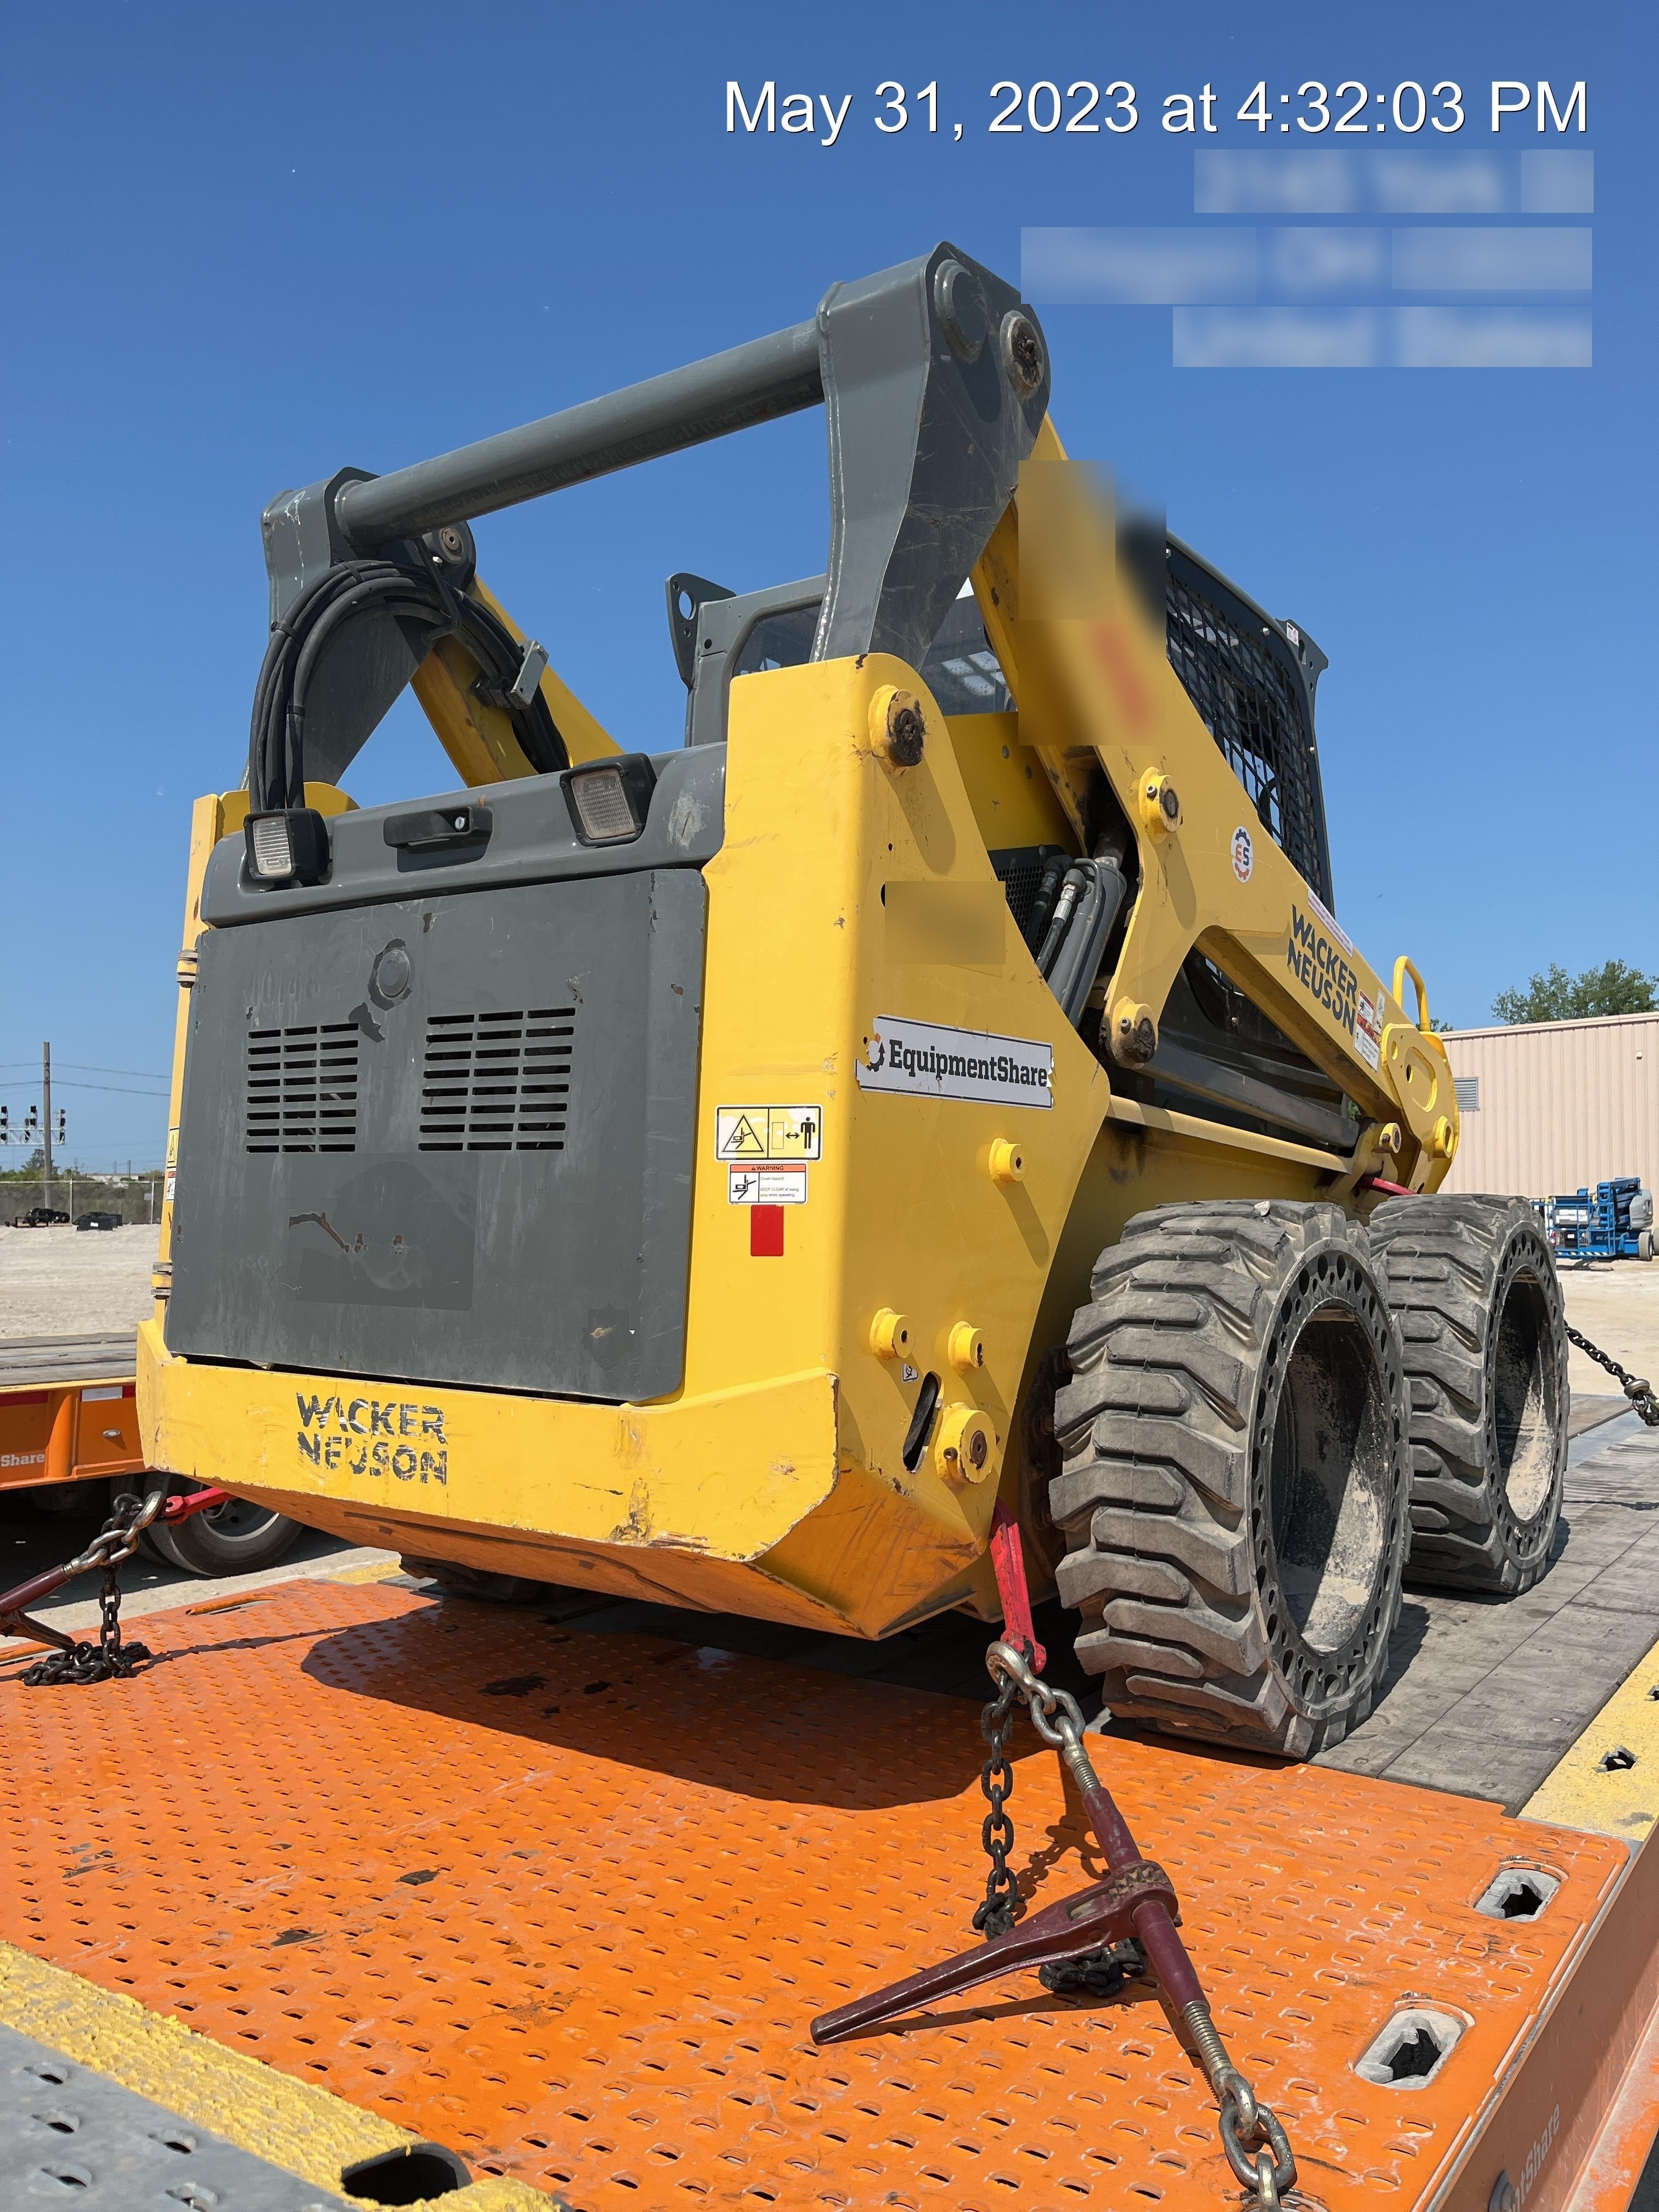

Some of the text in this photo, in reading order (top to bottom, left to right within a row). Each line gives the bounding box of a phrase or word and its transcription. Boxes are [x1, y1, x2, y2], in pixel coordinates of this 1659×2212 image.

[1291, 903, 1358, 1006] WACKER
[1286, 937, 1356, 1036] NEUSON
[889, 1039, 1048, 1087] EquipmentShare
[296, 1392, 448, 1444] WACKER
[0, 1453, 45, 1467] Share
[297, 1431, 448, 1486] NEUSON
